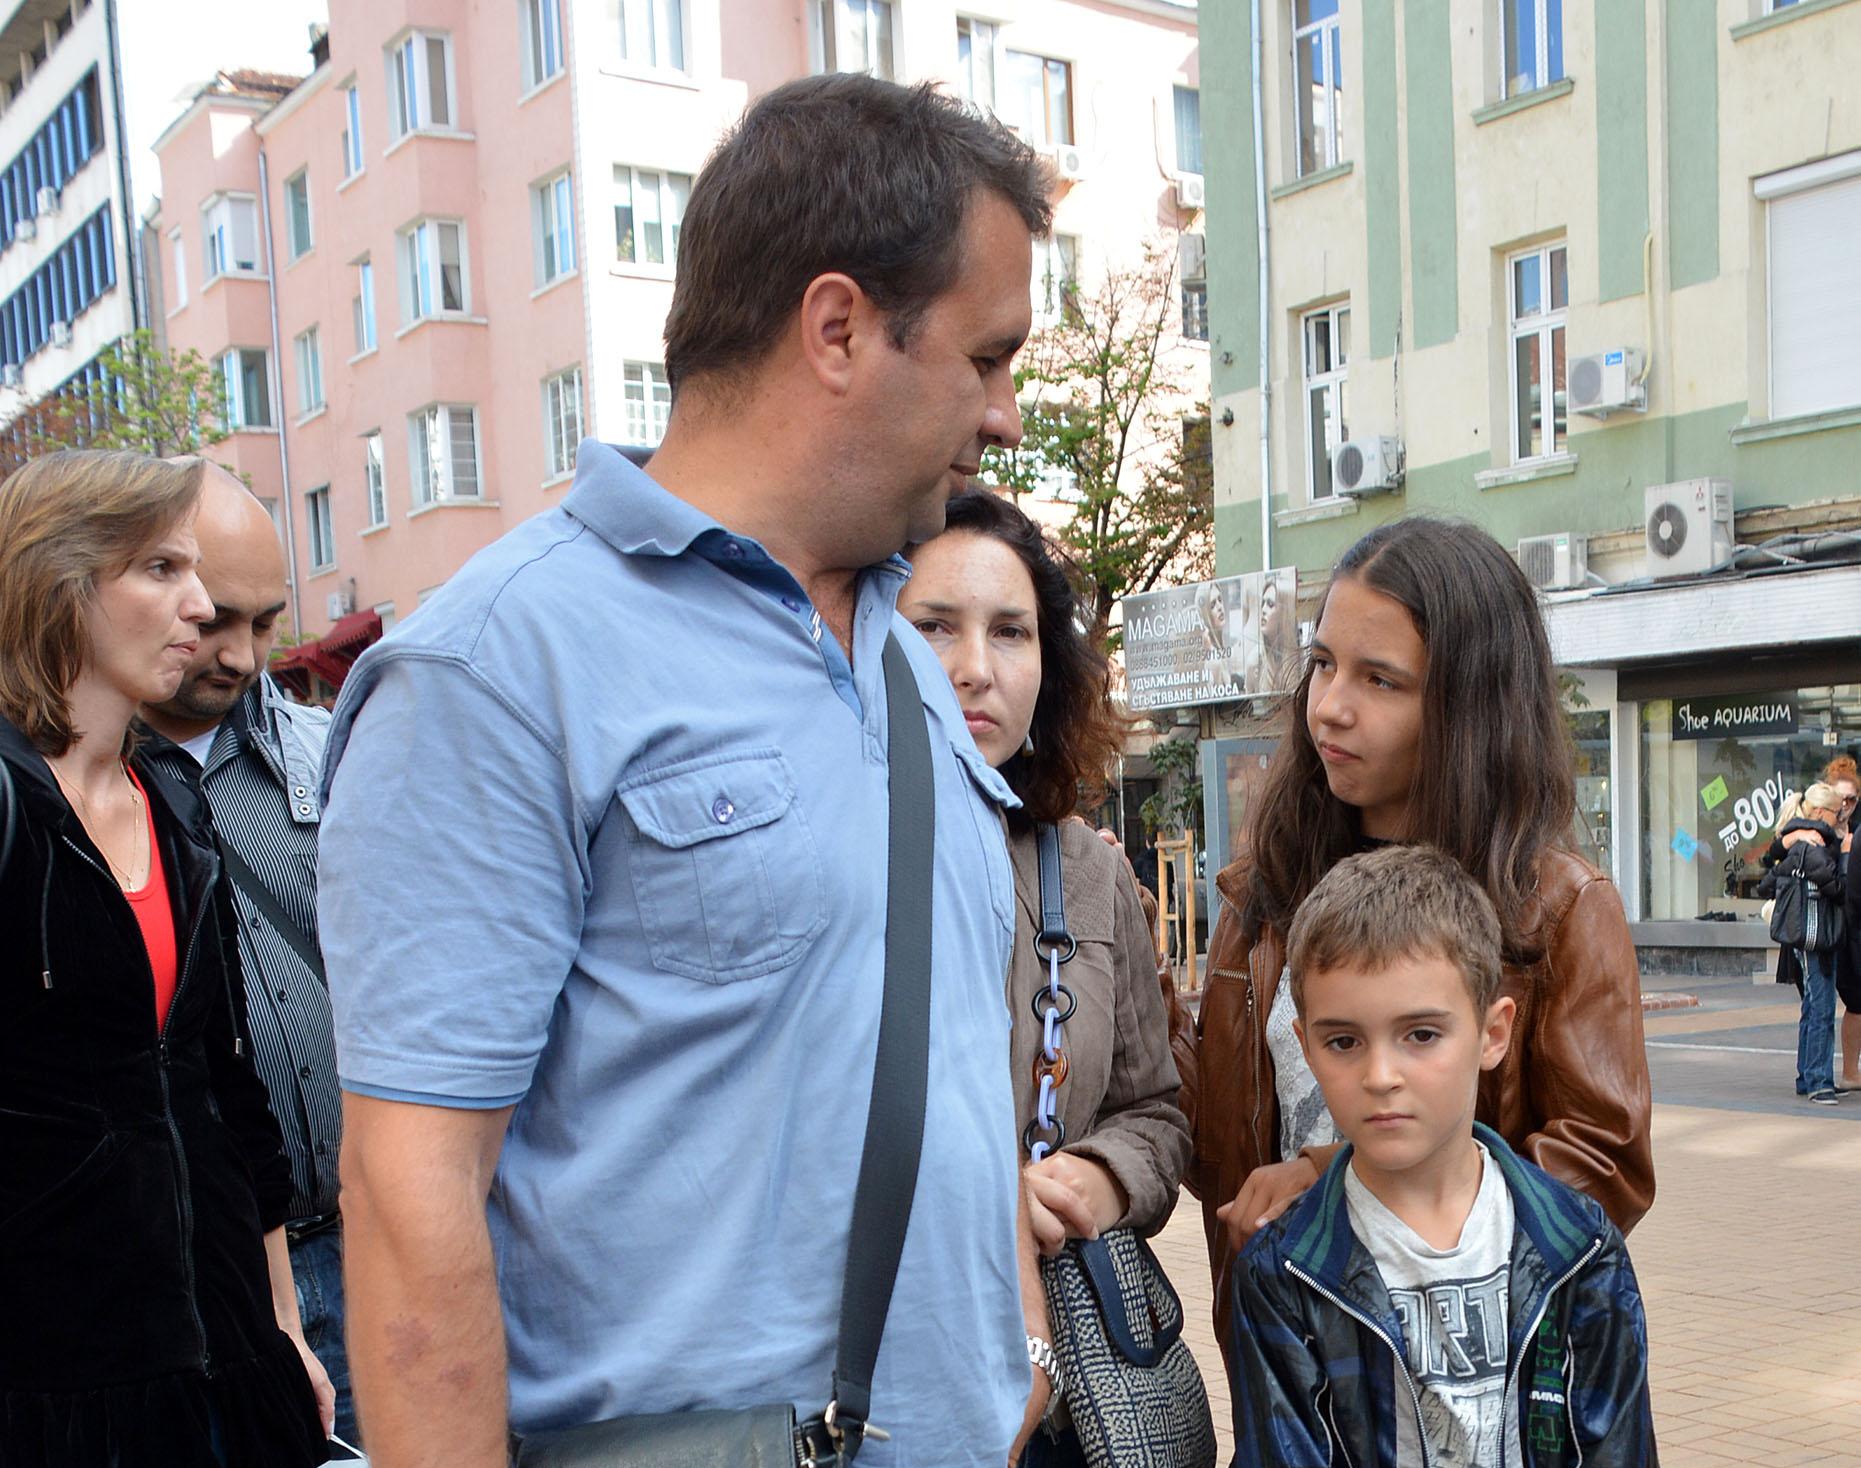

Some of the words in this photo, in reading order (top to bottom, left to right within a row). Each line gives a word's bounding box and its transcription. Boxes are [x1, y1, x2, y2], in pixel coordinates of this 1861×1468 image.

[1128, 608, 1204, 641] MAGAMA
[1131, 671, 1200, 691] УДЪЛЖАВАНЕ
[1132, 691, 1193, 706] СГЪСТЯВАНЕ
[1195, 687, 1209, 699] НА
[1210, 683, 1239, 698] КОСА
[1714, 704, 1792, 727] AQUARIUM
